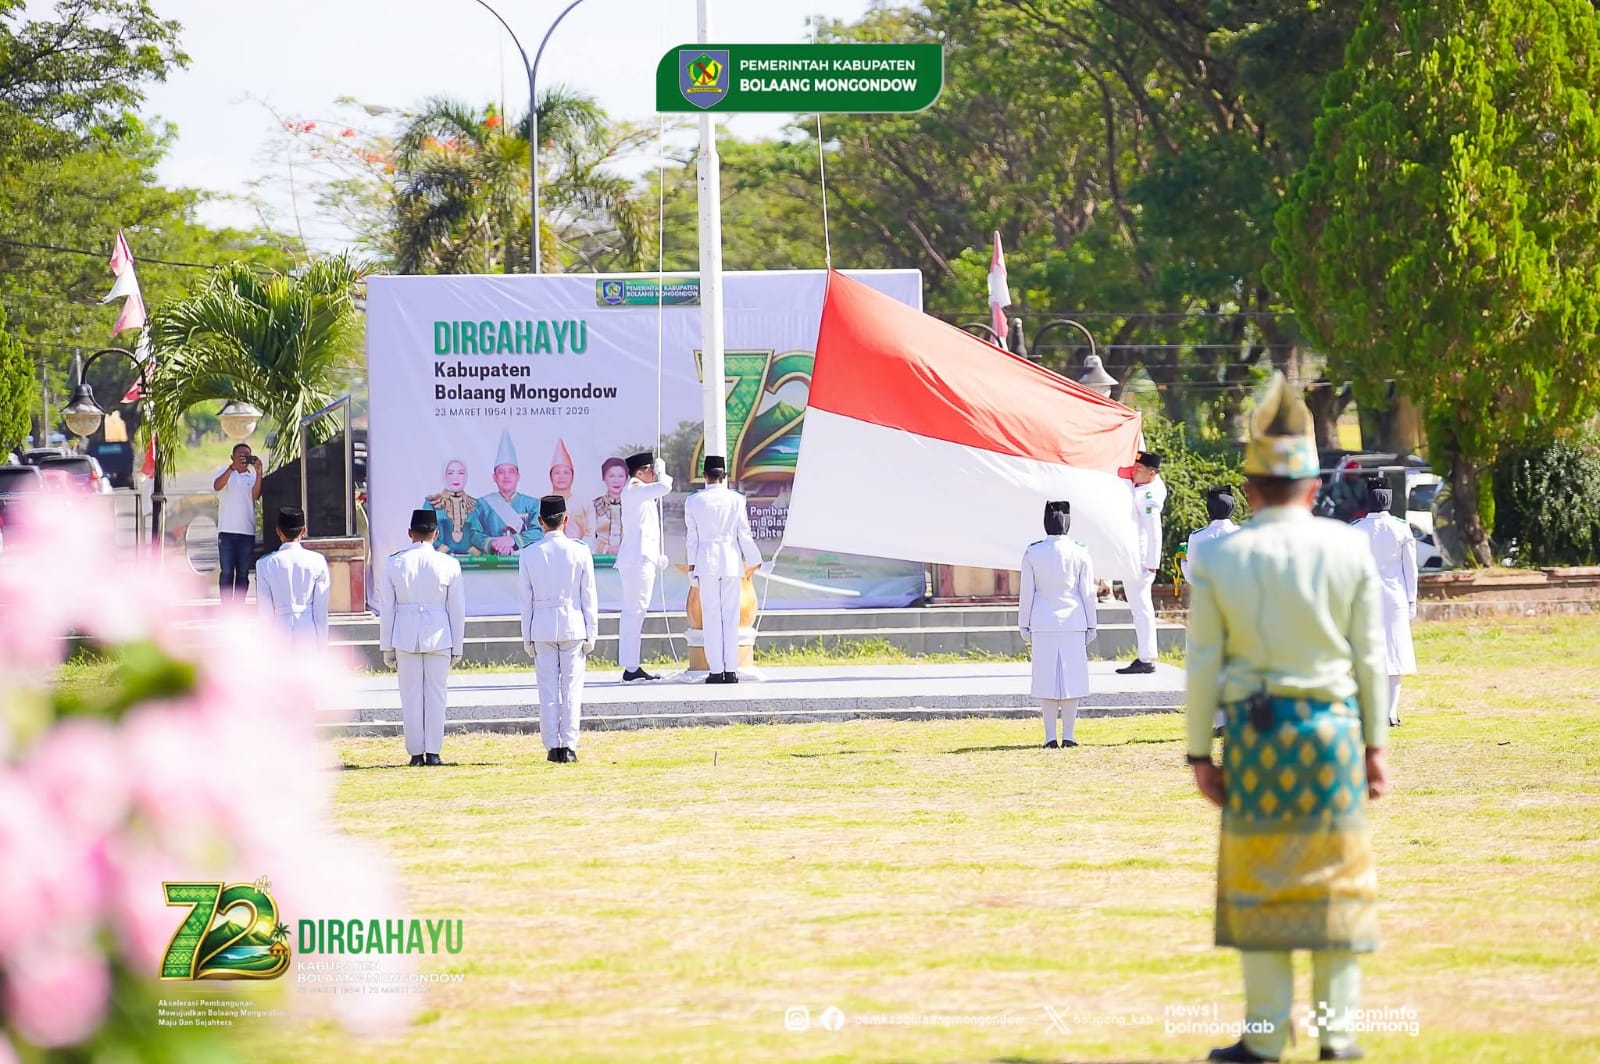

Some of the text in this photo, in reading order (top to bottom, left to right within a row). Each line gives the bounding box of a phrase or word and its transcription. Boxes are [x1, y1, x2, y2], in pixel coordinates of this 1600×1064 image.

[434, 320, 587, 355] DIRGAHAYU
[434, 361, 531, 381] Kabupaten
[435, 383, 617, 403] Bolaang Mongondow
[435, 408, 446, 416] 23
[450, 407, 480, 416] MARET
[484, 407, 506, 416] 1954
[516, 407, 527, 416] 23
[531, 407, 562, 416] MARET
[566, 406, 590, 415] 2026
[750, 506, 789, 516] Pemban
